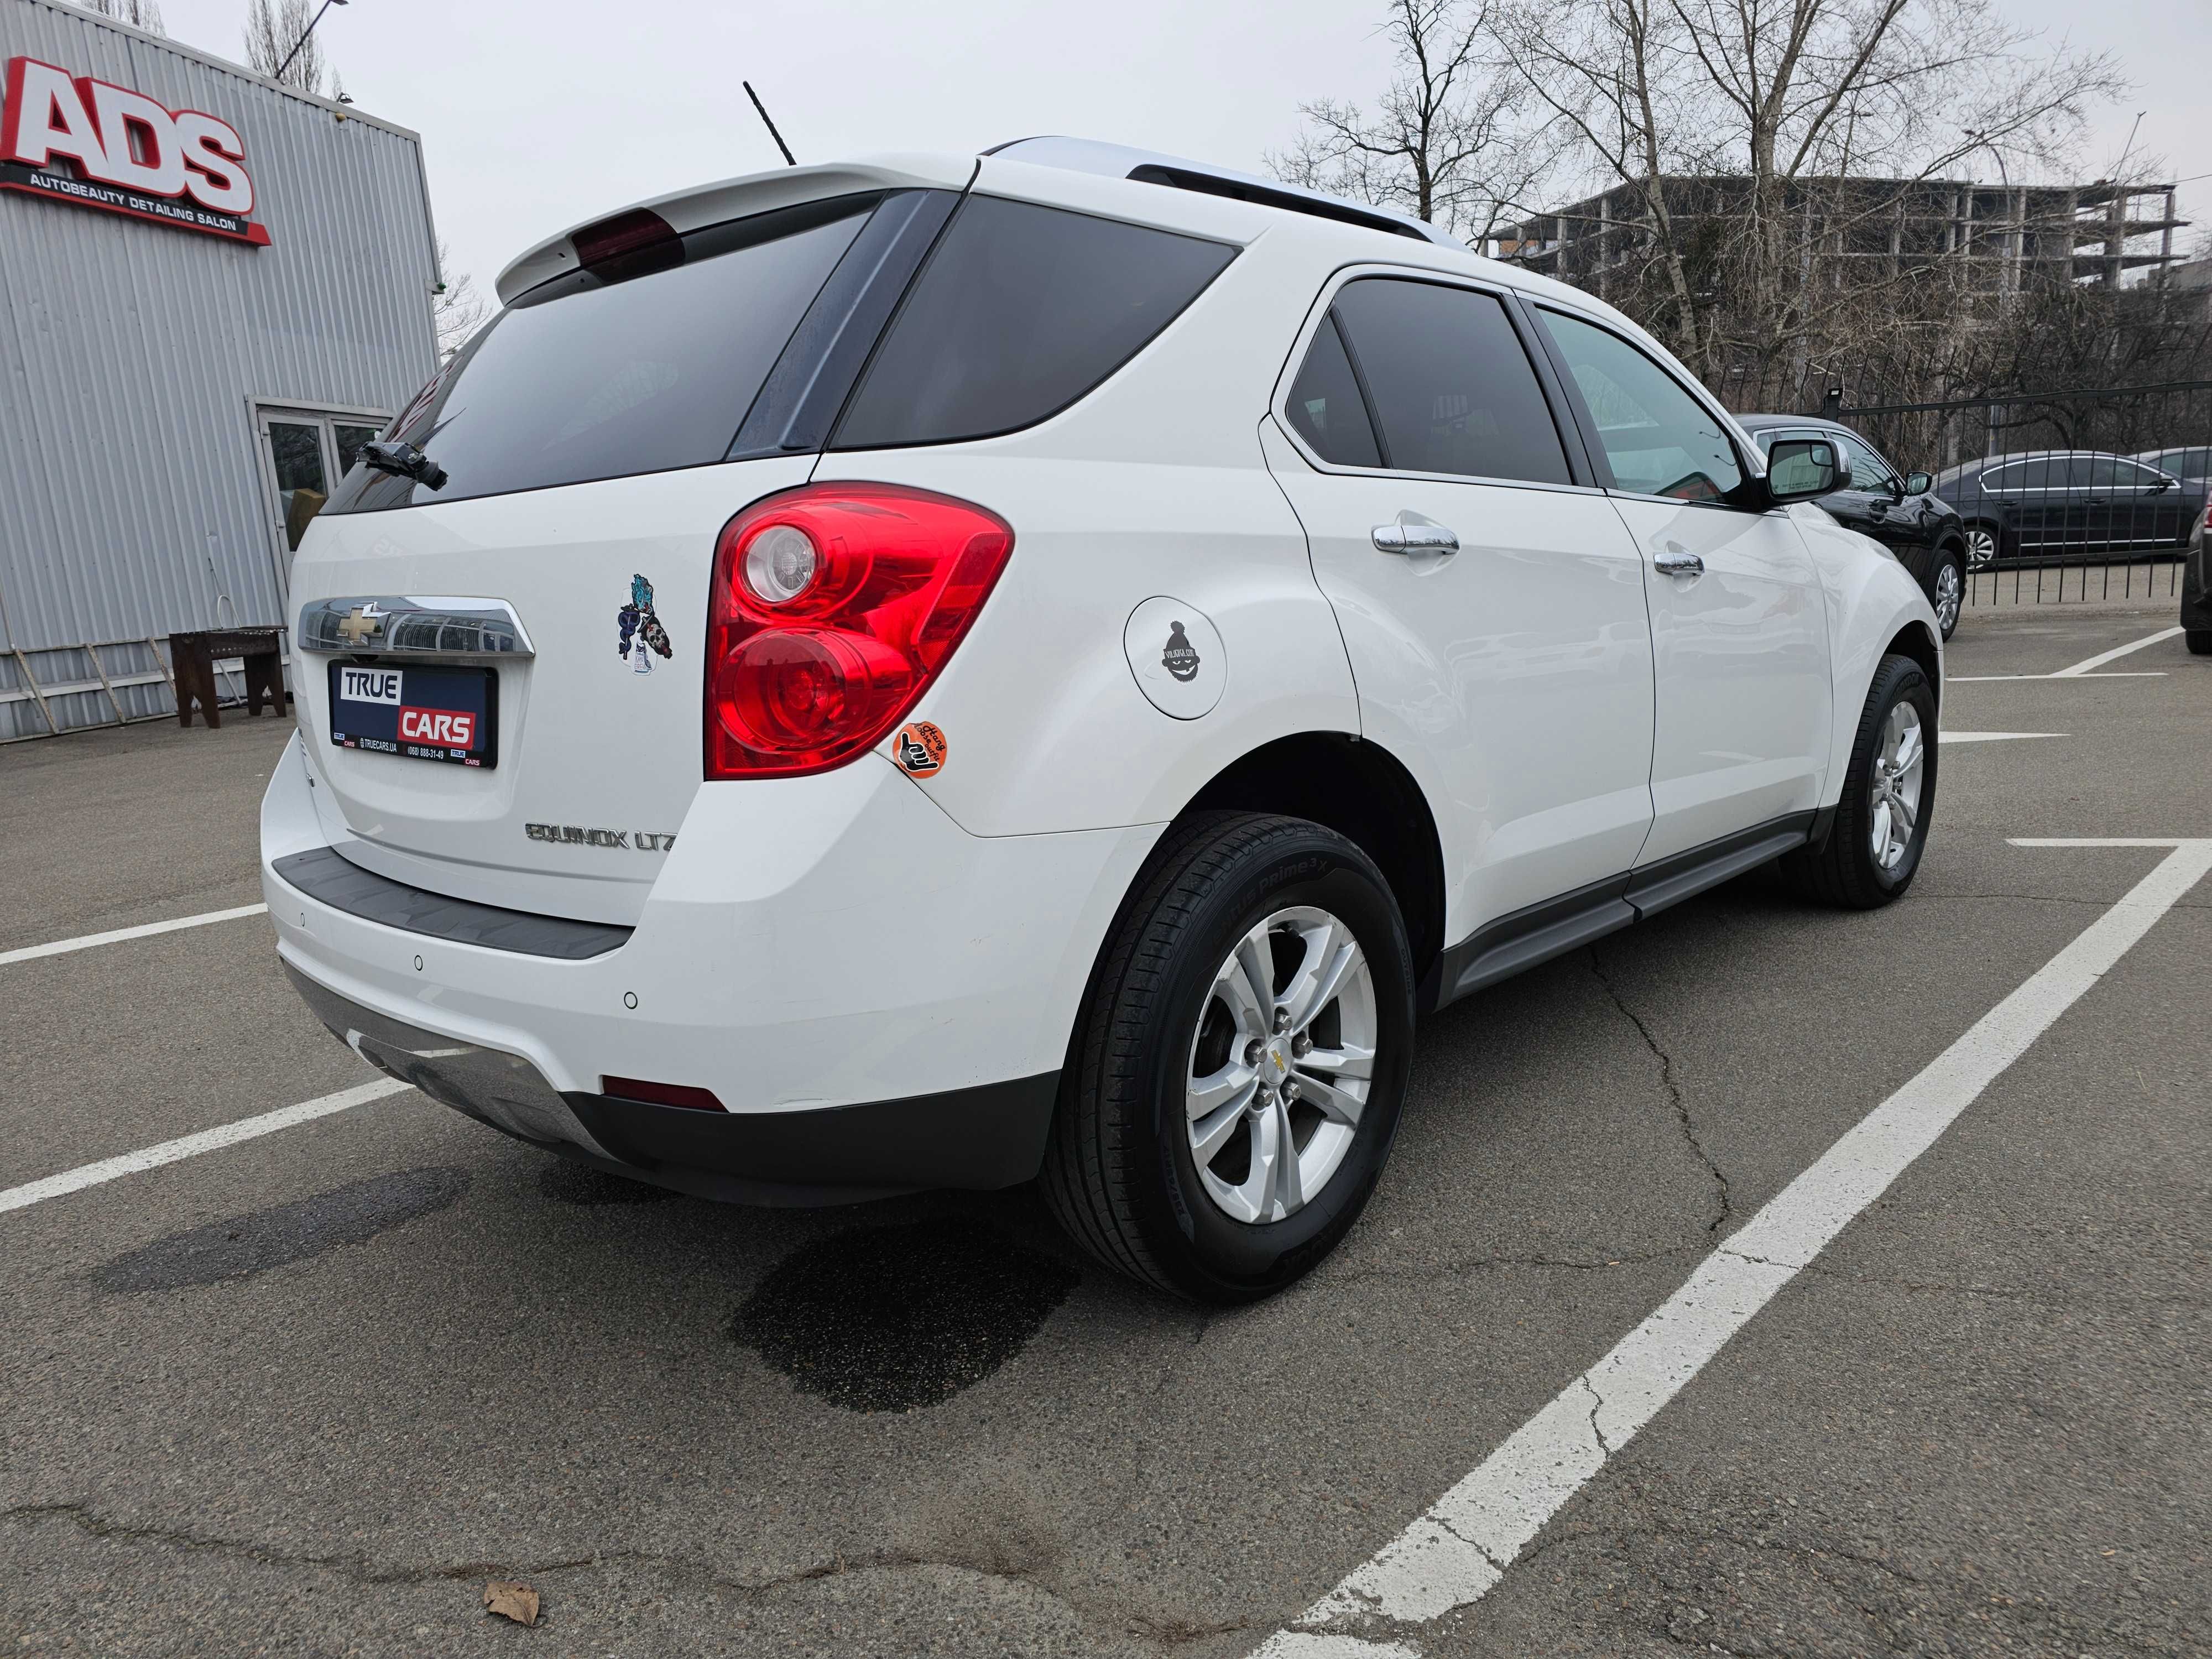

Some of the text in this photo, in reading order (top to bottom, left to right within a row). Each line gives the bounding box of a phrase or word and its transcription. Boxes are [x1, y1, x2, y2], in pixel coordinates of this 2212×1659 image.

[12, 57, 254, 215] ADS
[30, 174, 236, 231] AUTOBEAUTY DETAILING SALON
[345, 671, 398, 700] TRUE
[402, 711, 471, 744] CARS
[922, 725, 945, 752] Hang
[364, 739, 397, 752] TRUECARS.UA
[525, 822, 630, 849] EQUINOX
